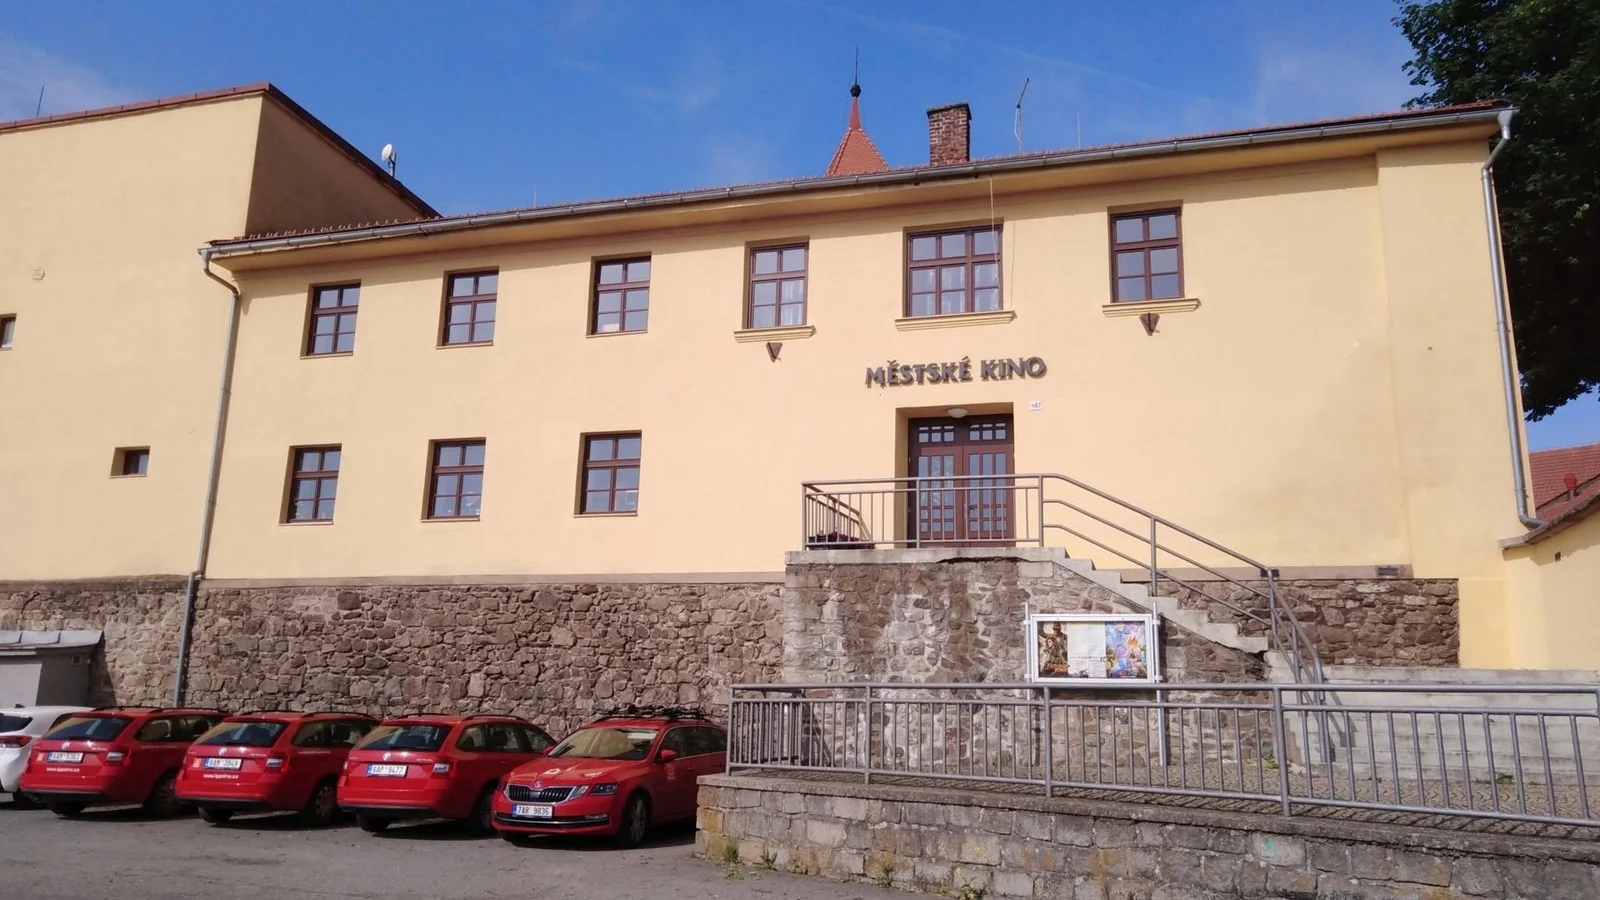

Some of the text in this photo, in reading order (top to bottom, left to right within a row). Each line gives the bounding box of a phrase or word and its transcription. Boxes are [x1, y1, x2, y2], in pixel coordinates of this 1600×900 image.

[865, 355, 1047, 389] MĚSTSKÉ KINO
[388, 766, 404, 774] 9477
[518, 806, 550, 816] 7AR 9836
